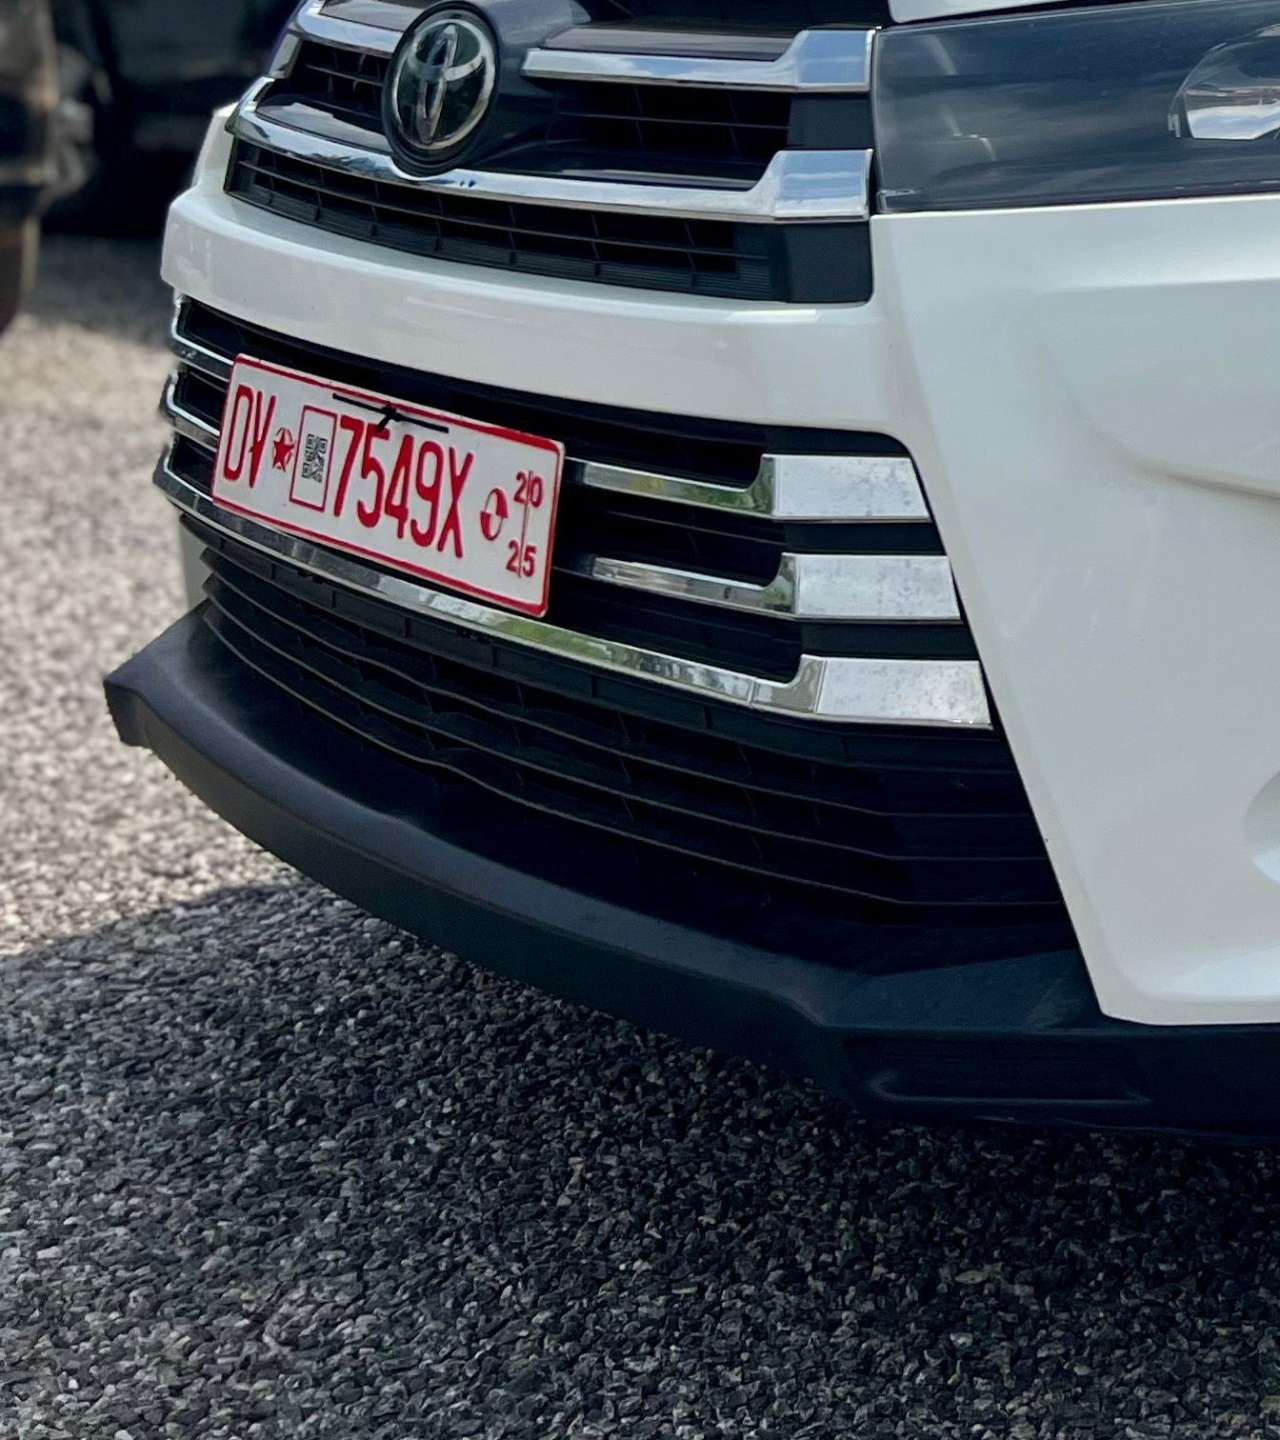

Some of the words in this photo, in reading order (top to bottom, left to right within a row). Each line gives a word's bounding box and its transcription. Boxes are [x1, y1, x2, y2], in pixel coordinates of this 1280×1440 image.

[223, 384, 277, 488] DV
[333, 414, 474, 559] 7549X
[513, 470, 543, 508] 20
[505, 539, 538, 578] 25
